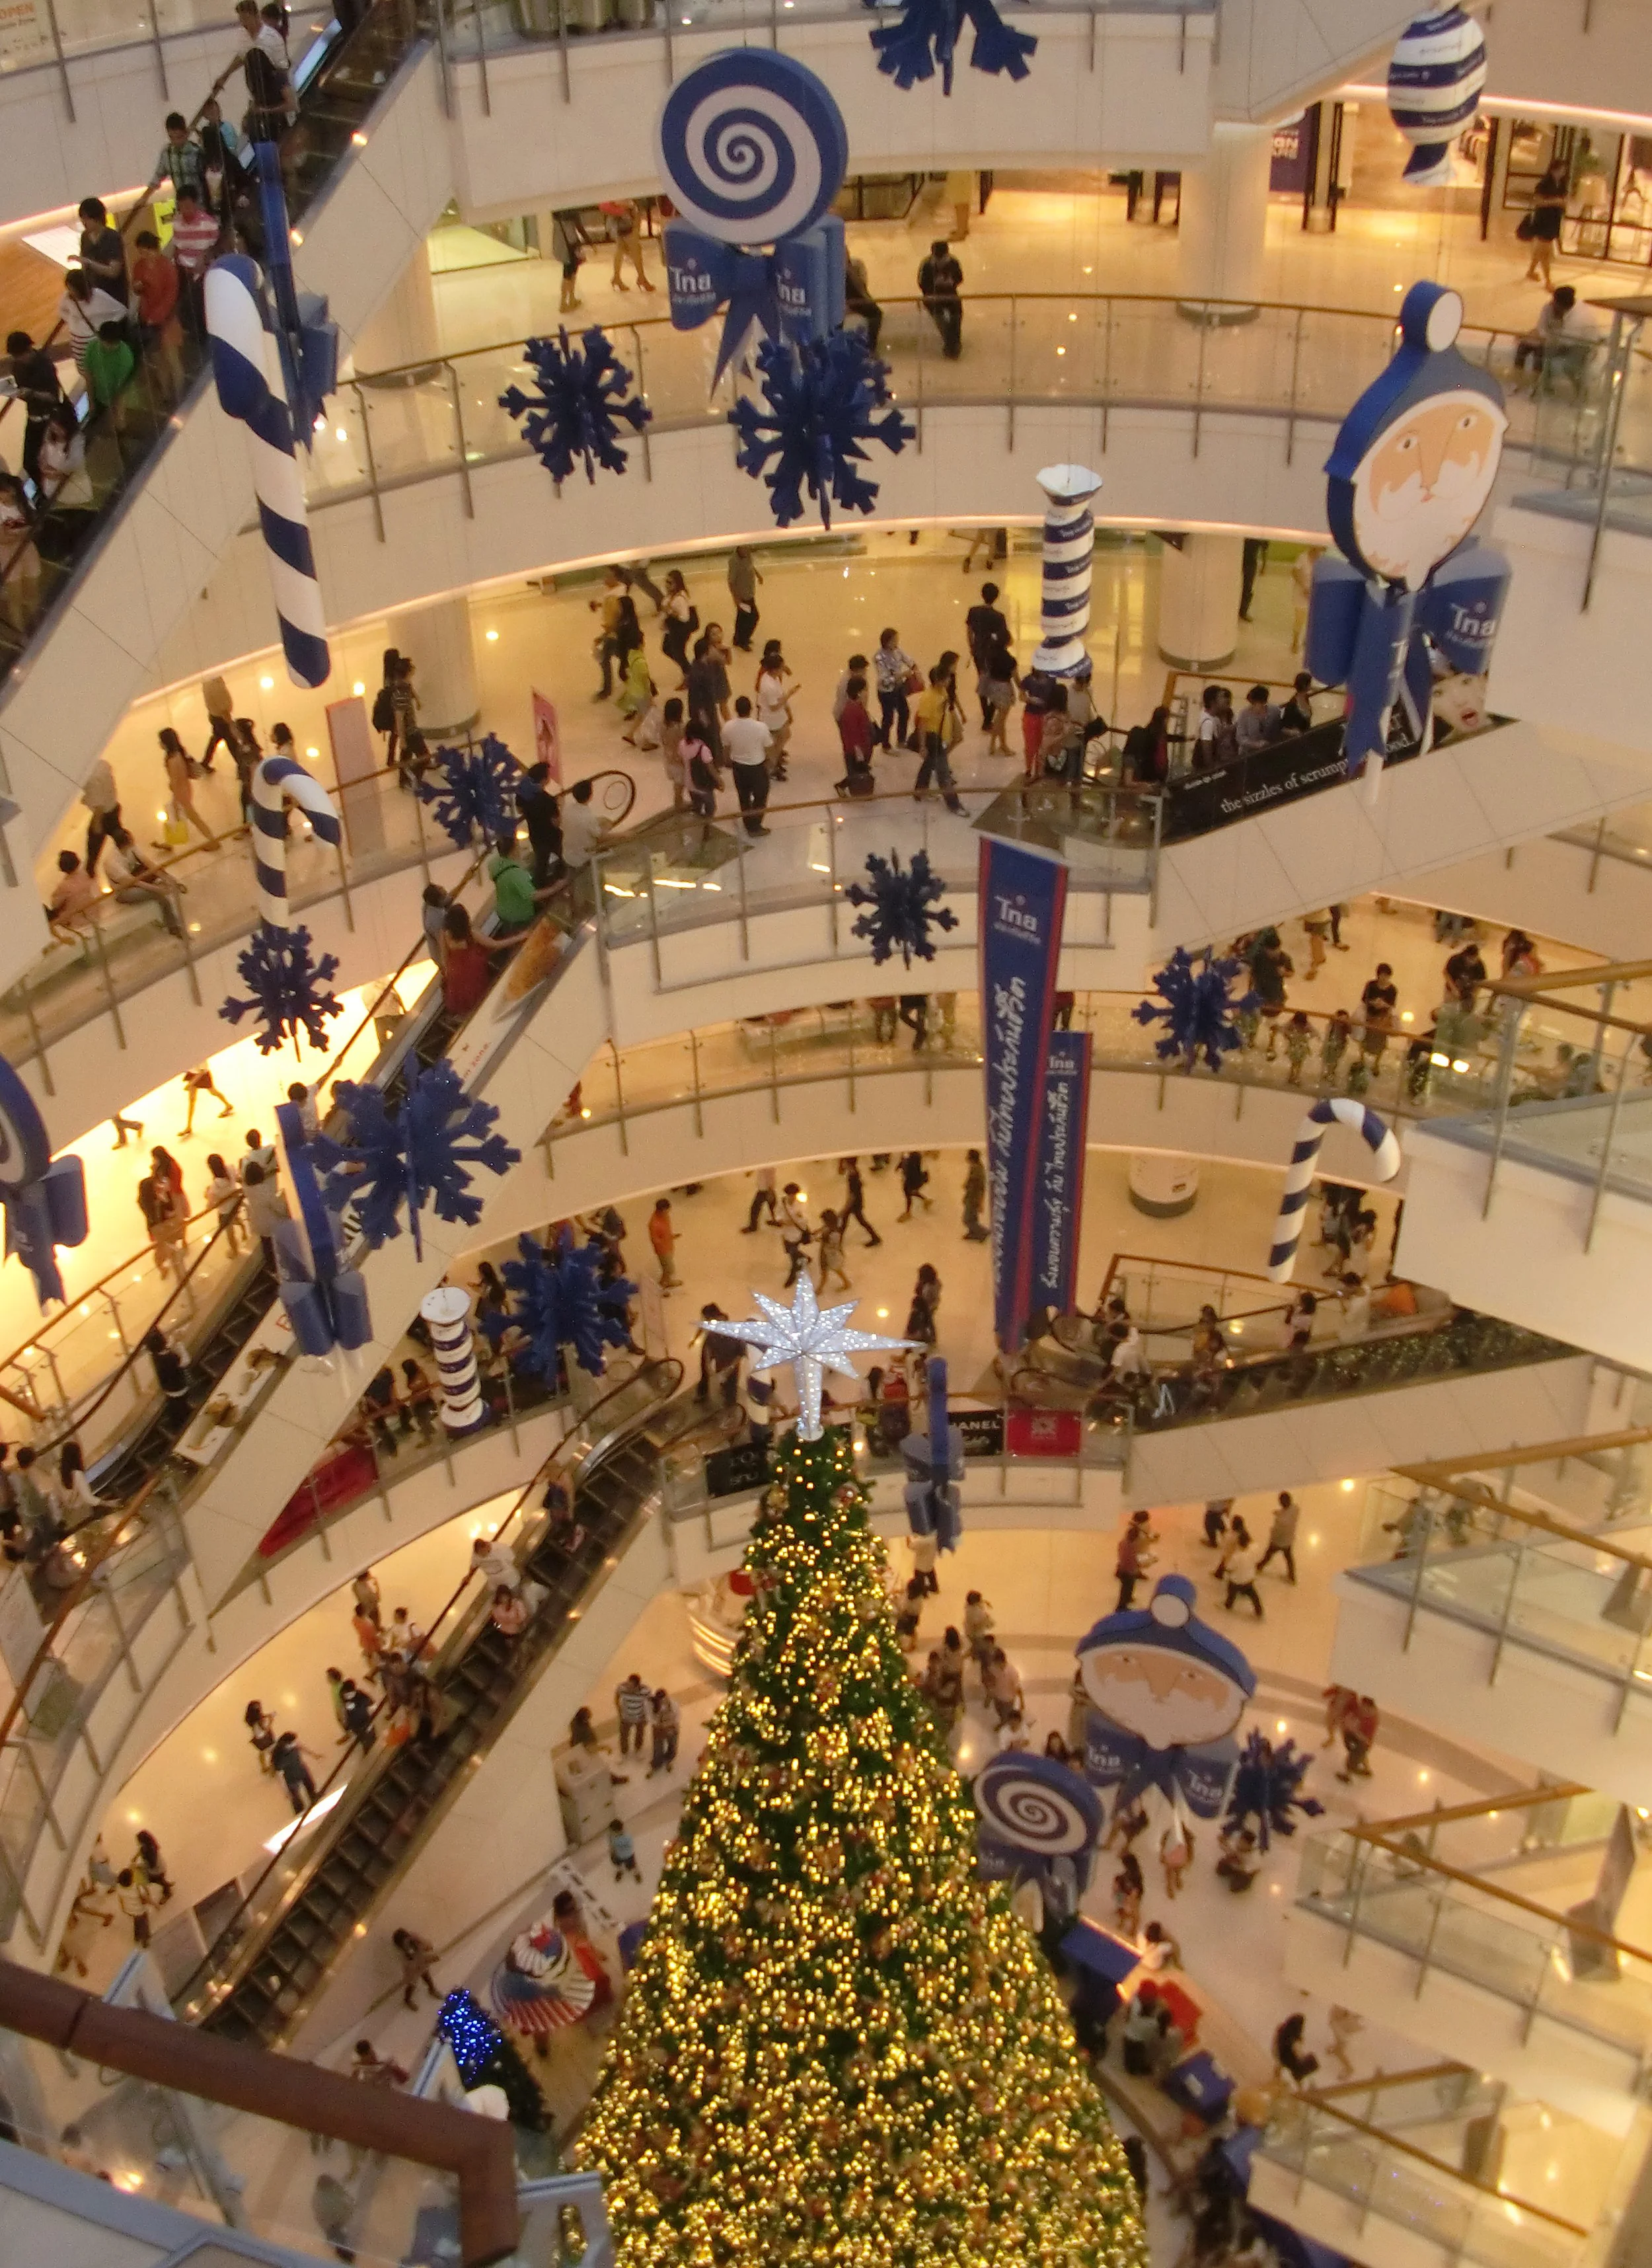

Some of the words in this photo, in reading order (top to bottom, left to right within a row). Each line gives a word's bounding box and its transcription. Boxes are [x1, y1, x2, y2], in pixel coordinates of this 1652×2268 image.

[1220, 798, 1243, 813] the
[1285, 772, 1303, 789] of
[950, 1421, 1000, 1430] ANEL
